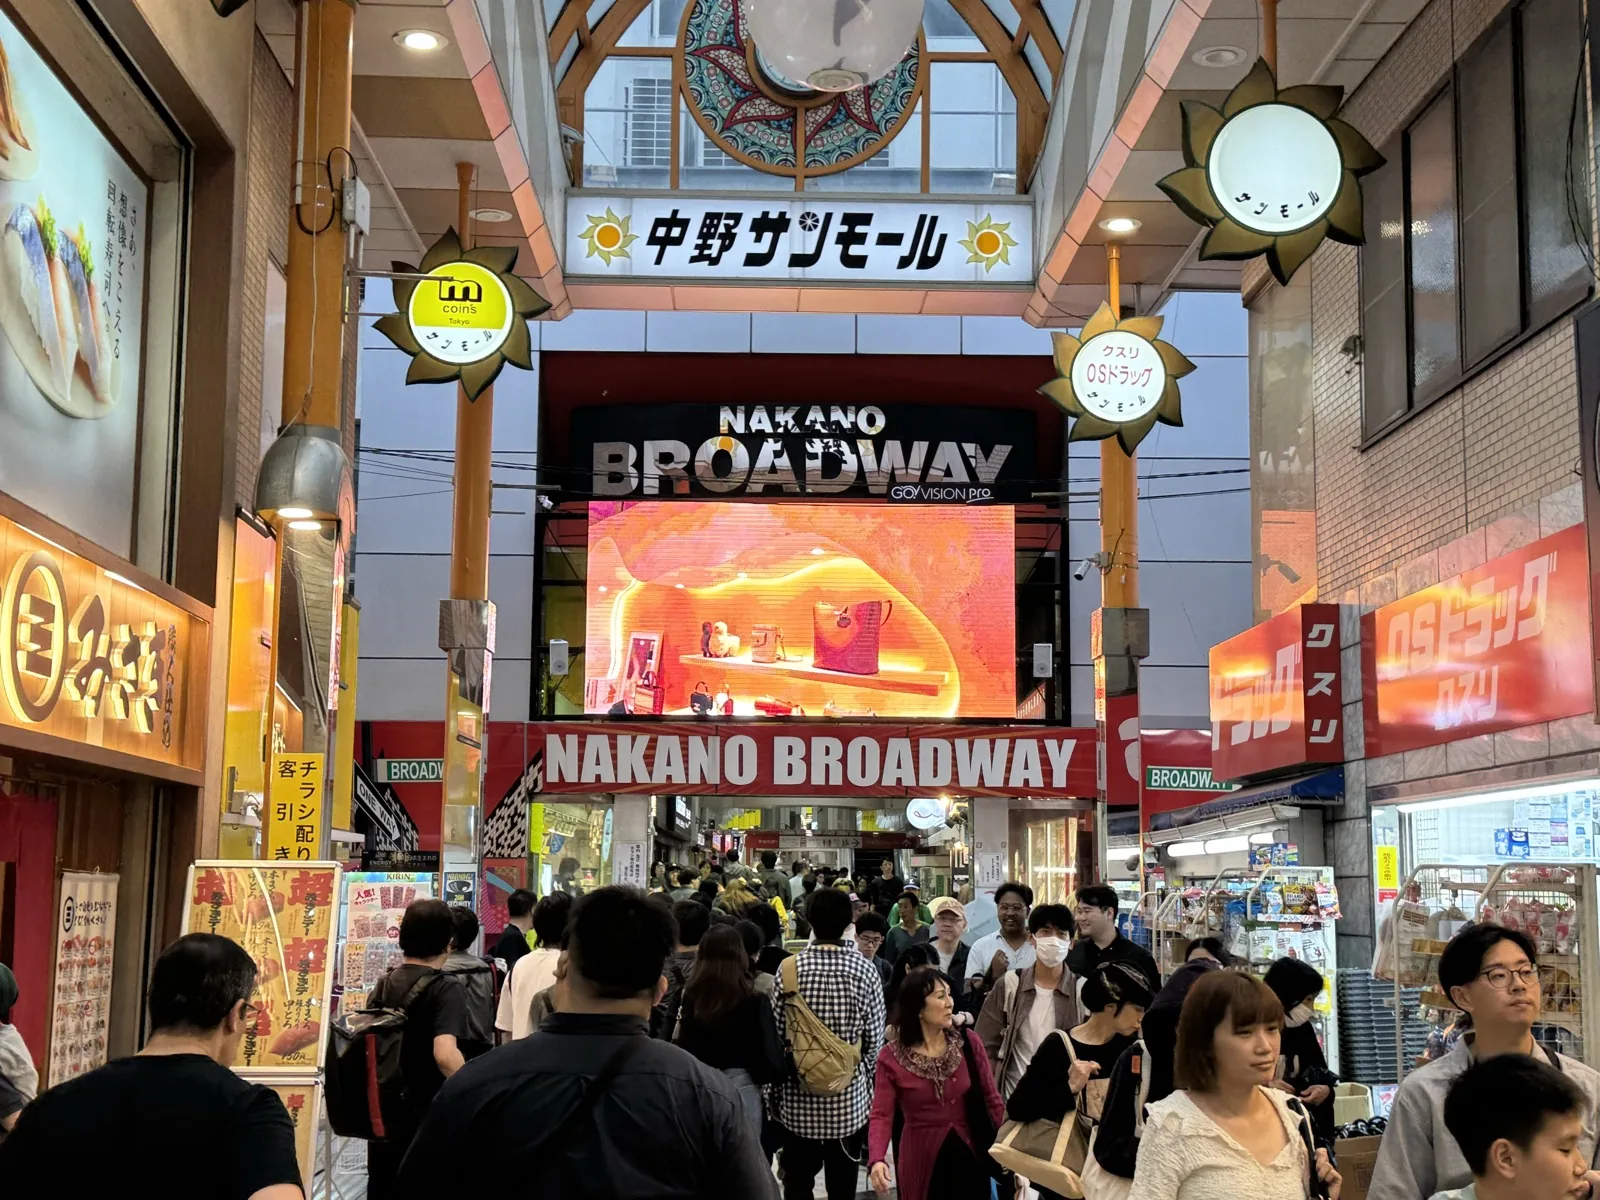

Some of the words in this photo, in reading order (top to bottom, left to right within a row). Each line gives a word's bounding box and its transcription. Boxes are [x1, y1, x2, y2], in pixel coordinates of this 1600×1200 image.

[1234, 190, 1320, 218] サンモール
[645, 208, 948, 270] 中野サンモール
[449, 317, 470, 325] Tokyo
[1087, 362, 1153, 388] OSドラッグ
[1101, 345, 1140, 359] クスリ
[720, 405, 886, 434] NAKANO
[592, 436, 1012, 496] BROADWAY
[1387, 550, 1557, 681] OSドラッグ
[1306, 623, 1337, 743] クスリ
[1435, 665, 1499, 731] クスリ
[545, 734, 758, 786] NAKANO
[772, 736, 1077, 789] BROADWAY
[1151, 770, 1226, 789] BROADW
[274, 760, 297, 859] 客引き
[295, 760, 318, 859] チラシ配り
[359, 783, 377, 811] ONE
[380, 809, 397, 834] WAY
